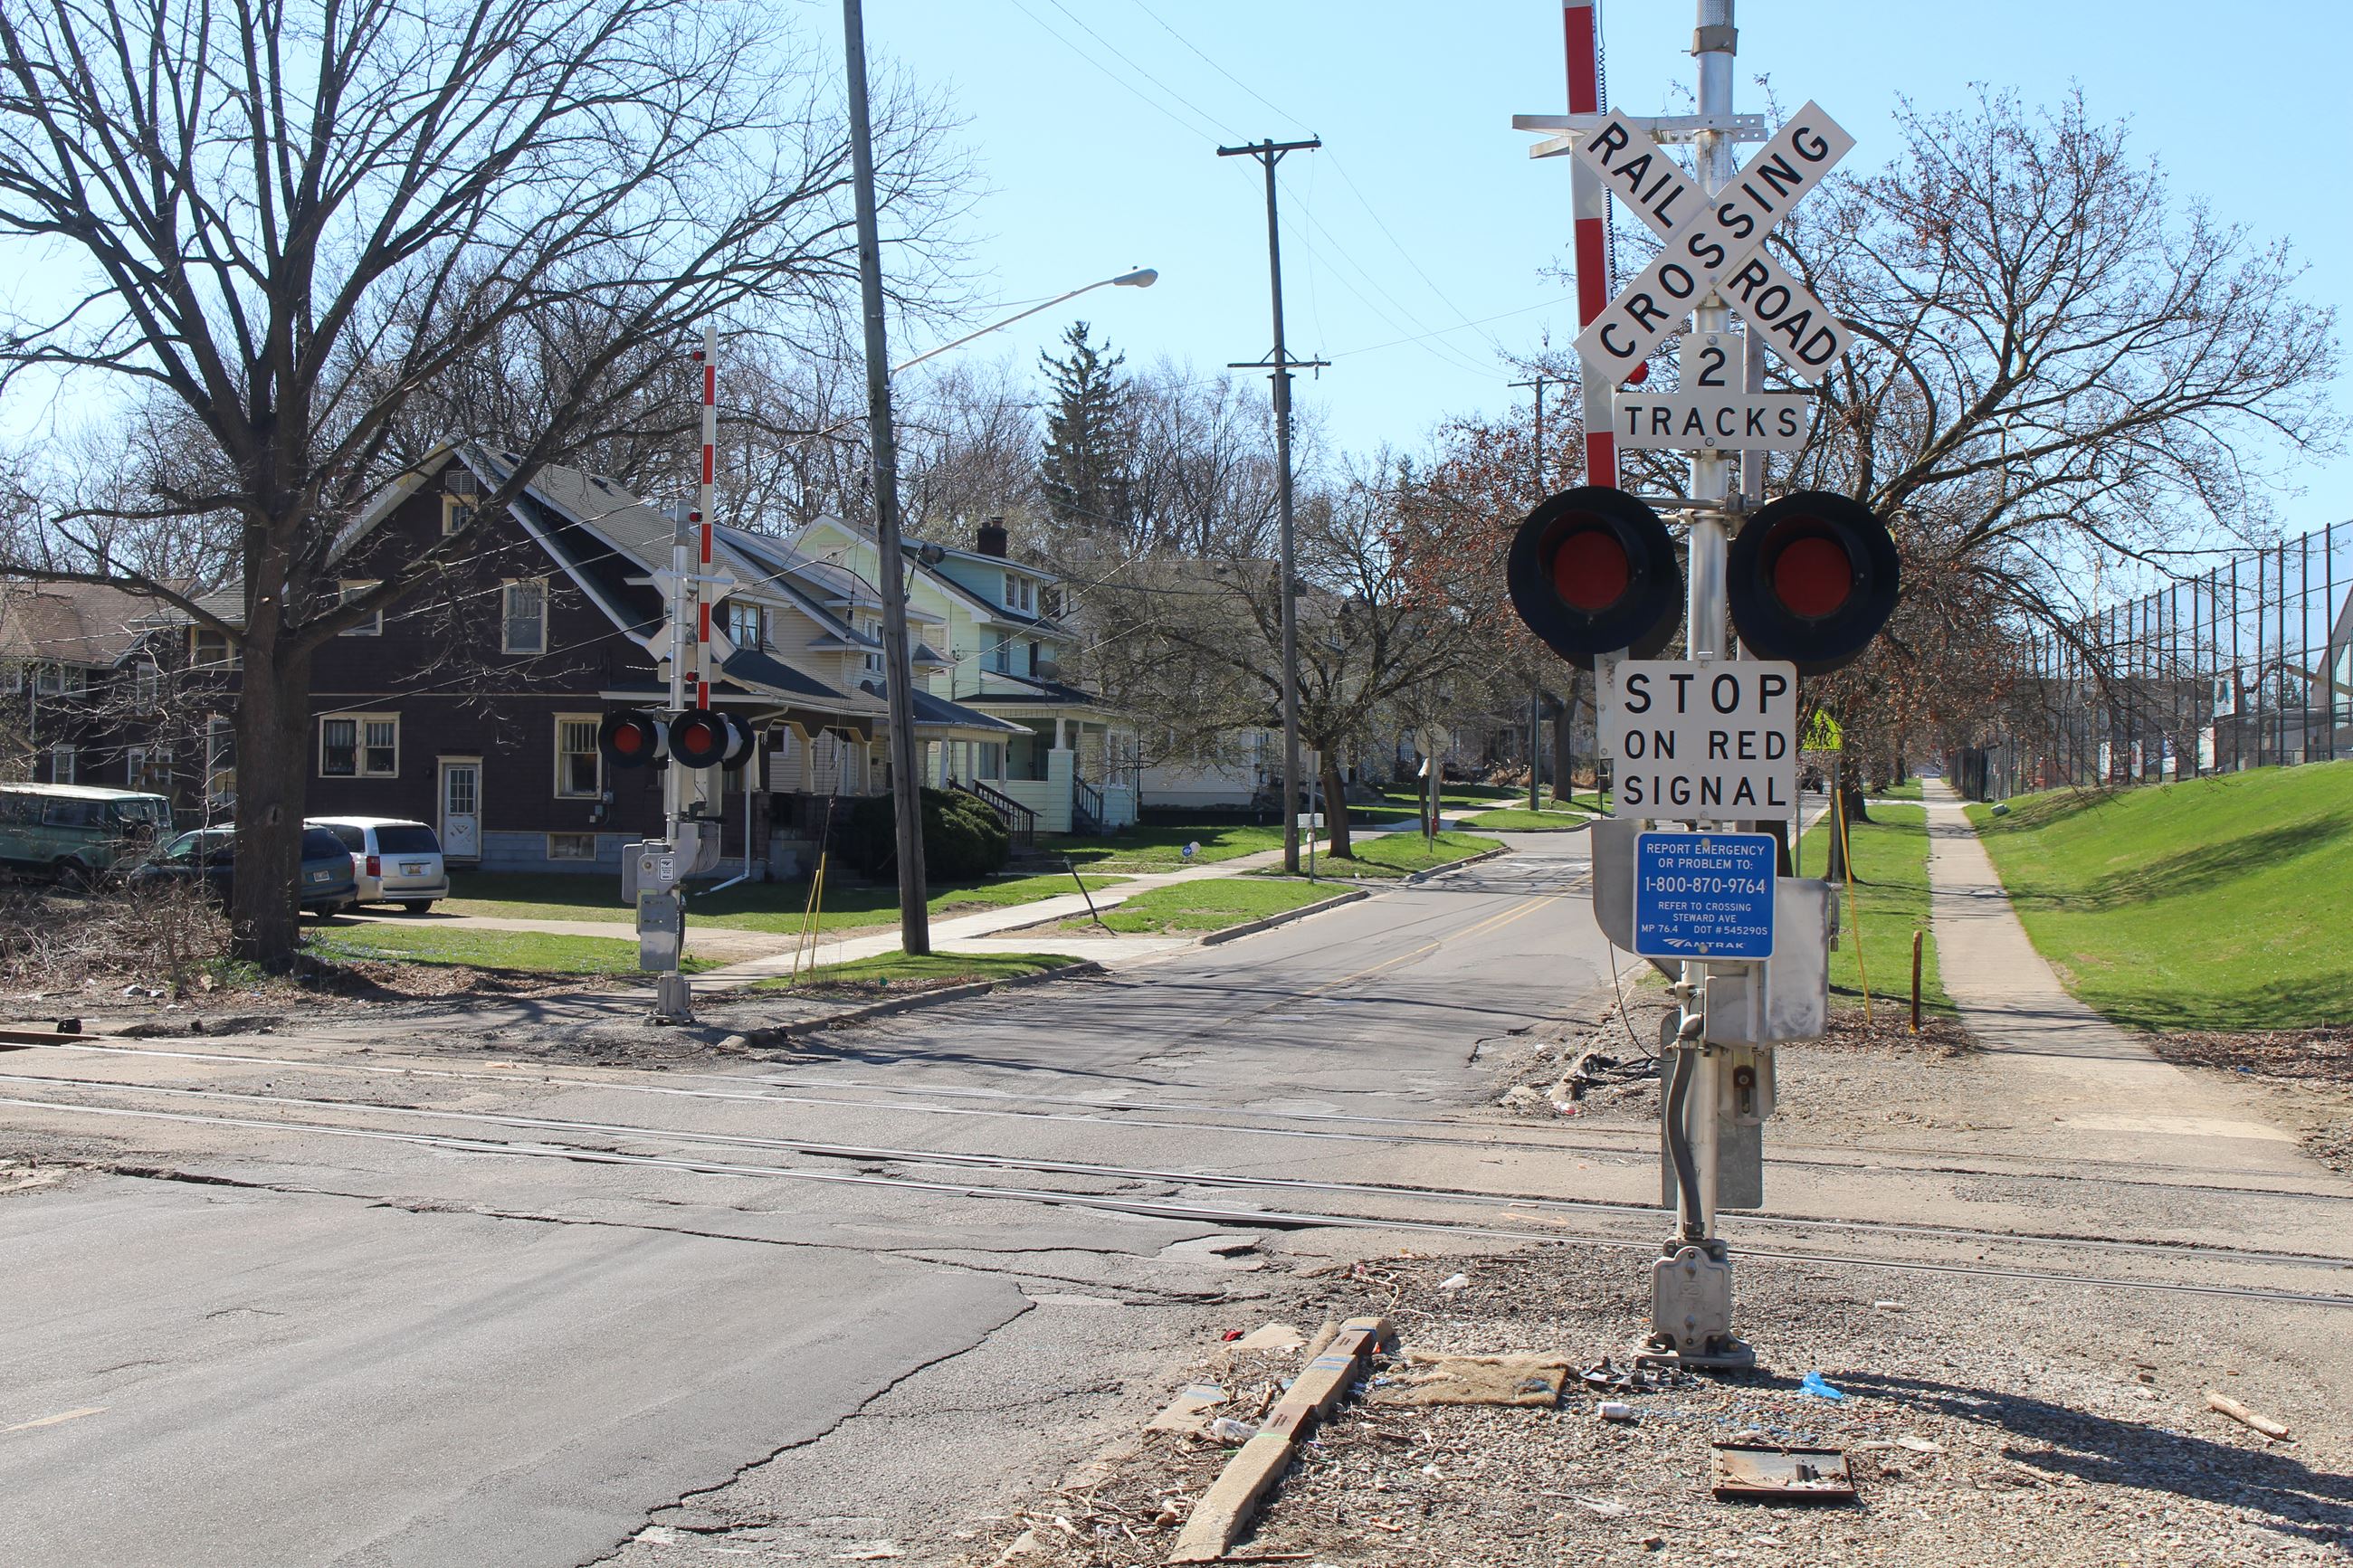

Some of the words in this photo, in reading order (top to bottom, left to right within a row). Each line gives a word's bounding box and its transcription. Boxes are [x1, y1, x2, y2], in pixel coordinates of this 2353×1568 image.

[1587, 121, 1684, 228] RAIL
[1600, 127, 1828, 358] CROSSING
[1728, 258, 1837, 366] ROAD
[1698, 347, 1726, 387] 2
[1624, 406, 1797, 437] TRACKS
[1624, 673, 1787, 714] STOP
[1624, 730, 1674, 760] ON
[1709, 730, 1786, 760] RED
[1624, 775, 1786, 806] SIGNAL
[1646, 843, 1691, 854] REPORT
[1695, 844, 1766, 856] EMERGENCY
[1658, 859, 1673, 869] OR
[1678, 859, 1732, 870] PROBLEM
[1737, 860, 1753, 870] TO:
[1645, 876, 1766, 894] 1-800-870-9764
[1658, 901, 1687, 910] REFER
[1691, 902, 1702, 910] TO
[1705, 903, 1752, 912] CROSSING
[1672, 913, 1715, 923] STEWARD
[1719, 915, 1737, 923] AVE
[1642, 924, 1655, 933] MP
[1658, 925, 1678, 933] 76.4
[1693, 926, 1712, 934] DOT
